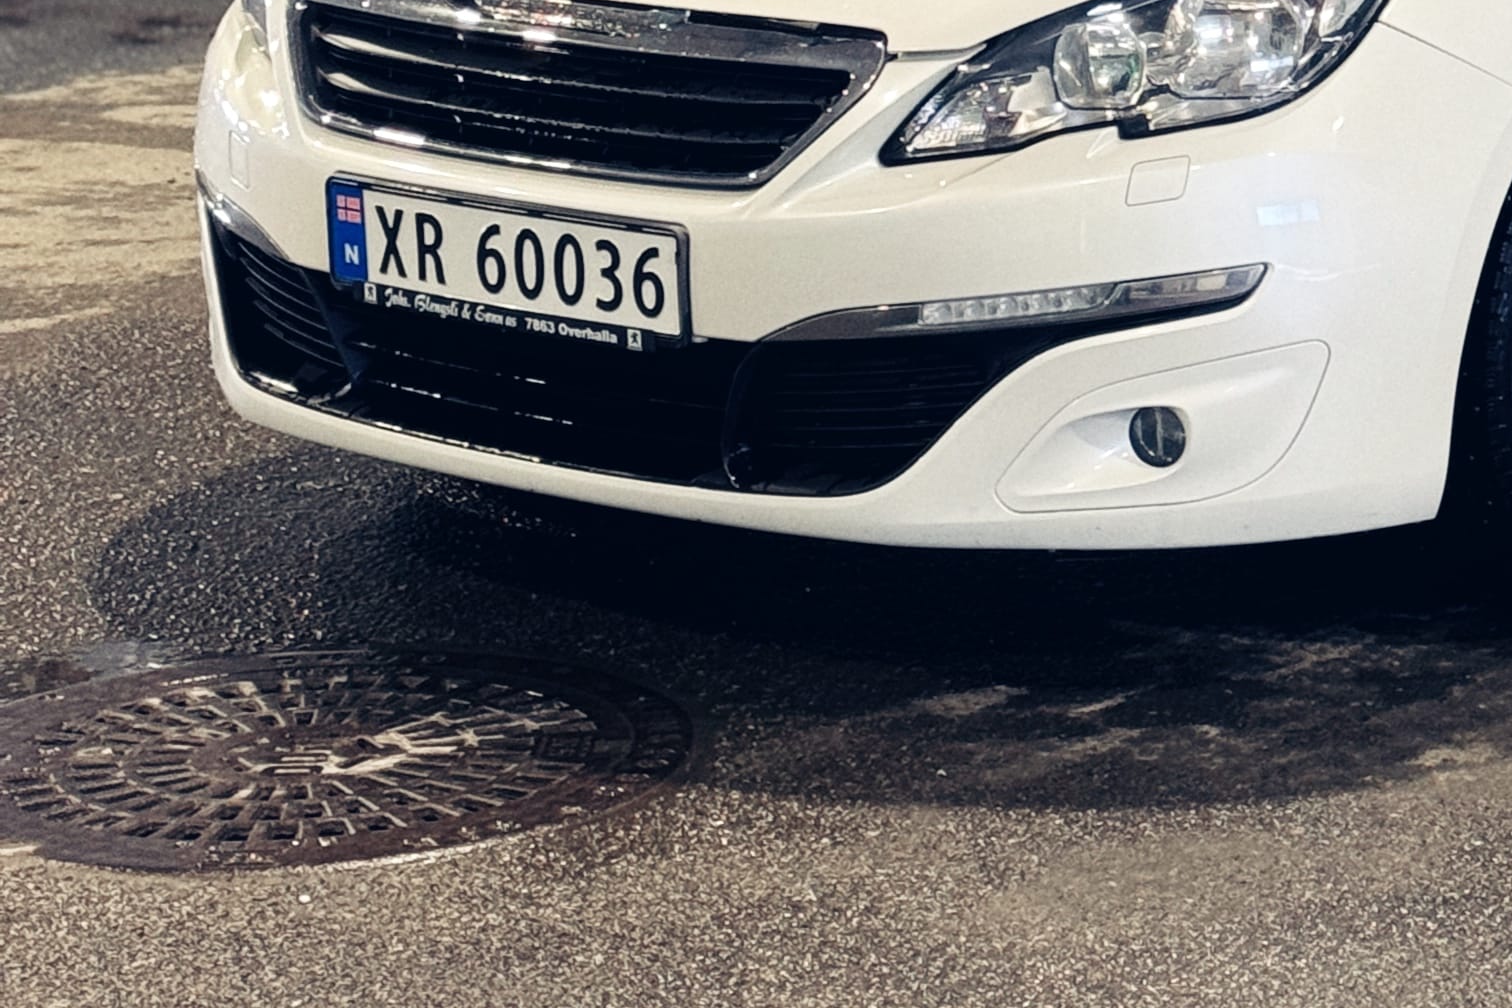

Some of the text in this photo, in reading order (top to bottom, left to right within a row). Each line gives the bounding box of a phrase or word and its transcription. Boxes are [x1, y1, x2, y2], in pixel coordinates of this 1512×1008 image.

[344, 243, 360, 266] N
[374, 205, 665, 319] XR 60036
[461, 301, 471, 321] &
[558, 322, 618, 344] Overhalla
